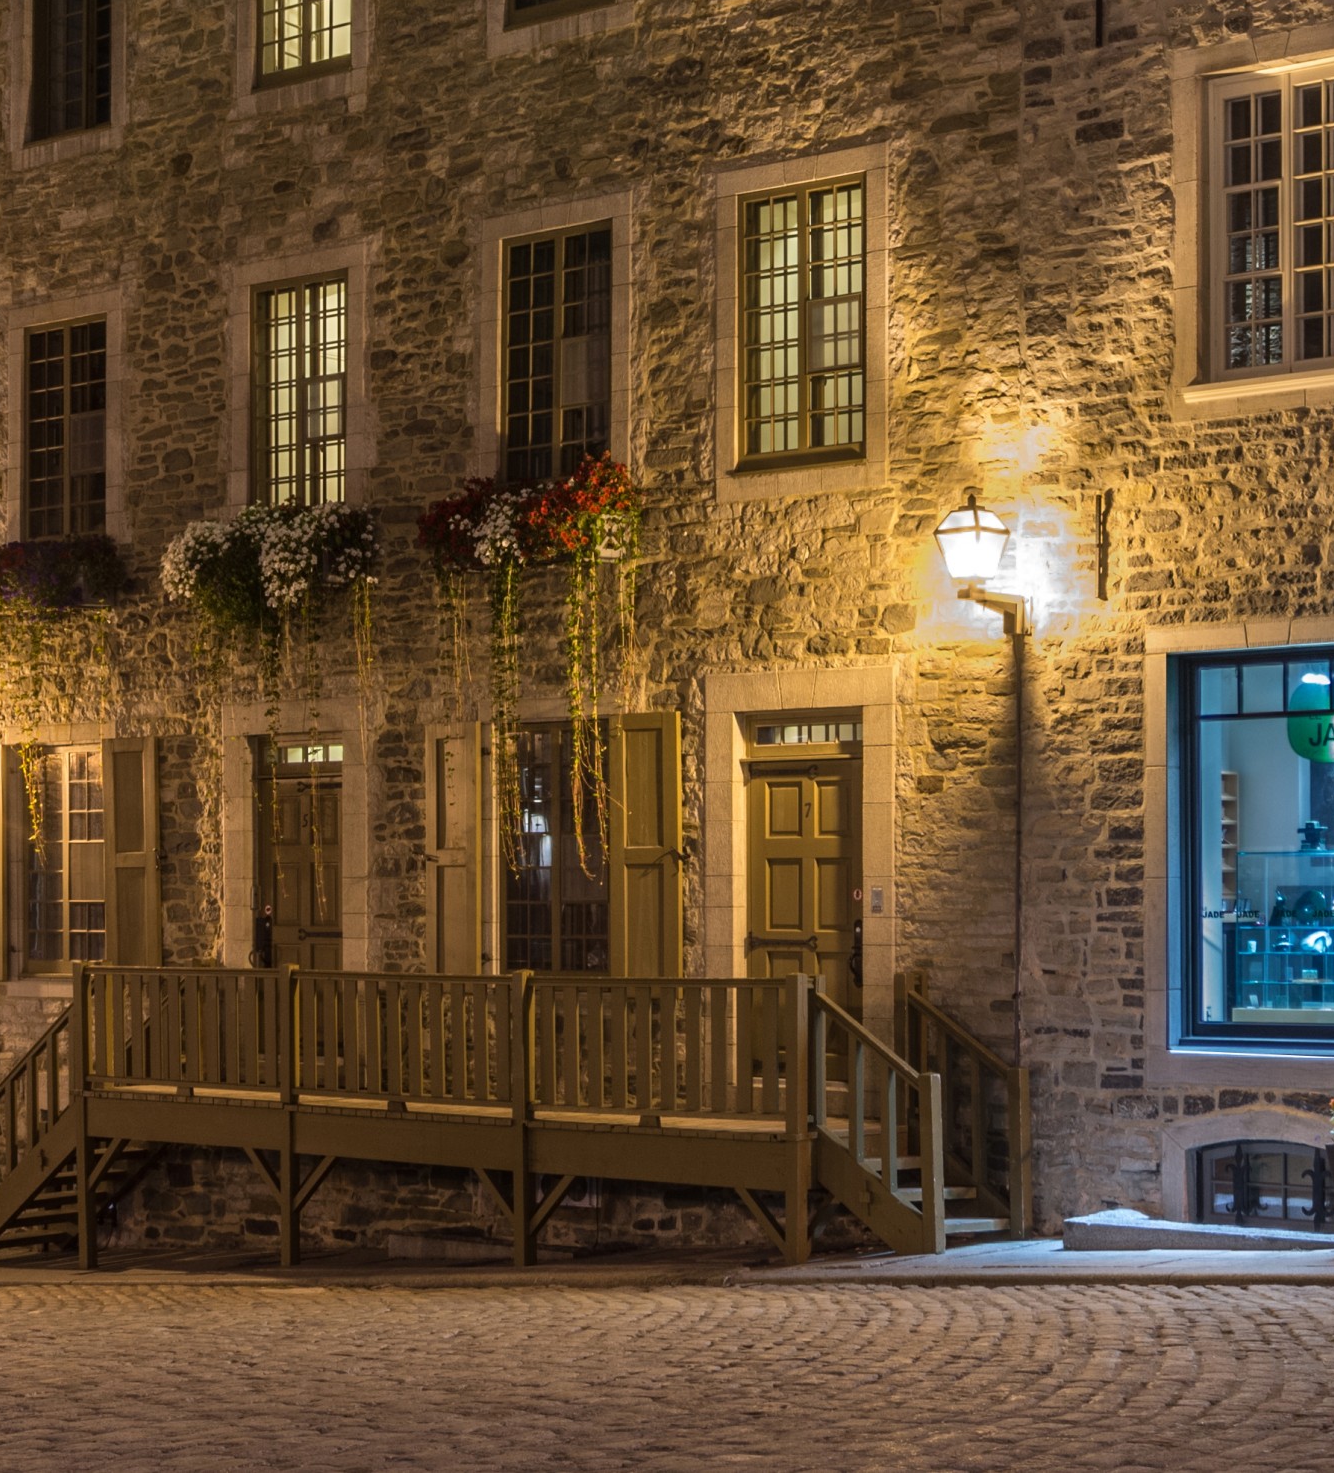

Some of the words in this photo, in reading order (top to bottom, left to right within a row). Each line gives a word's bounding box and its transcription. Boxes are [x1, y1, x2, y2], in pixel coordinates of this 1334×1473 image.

[804, 802, 811, 818] 7
[1203, 910, 1224, 918] JADE
[1237, 910, 1259, 918] JADE
